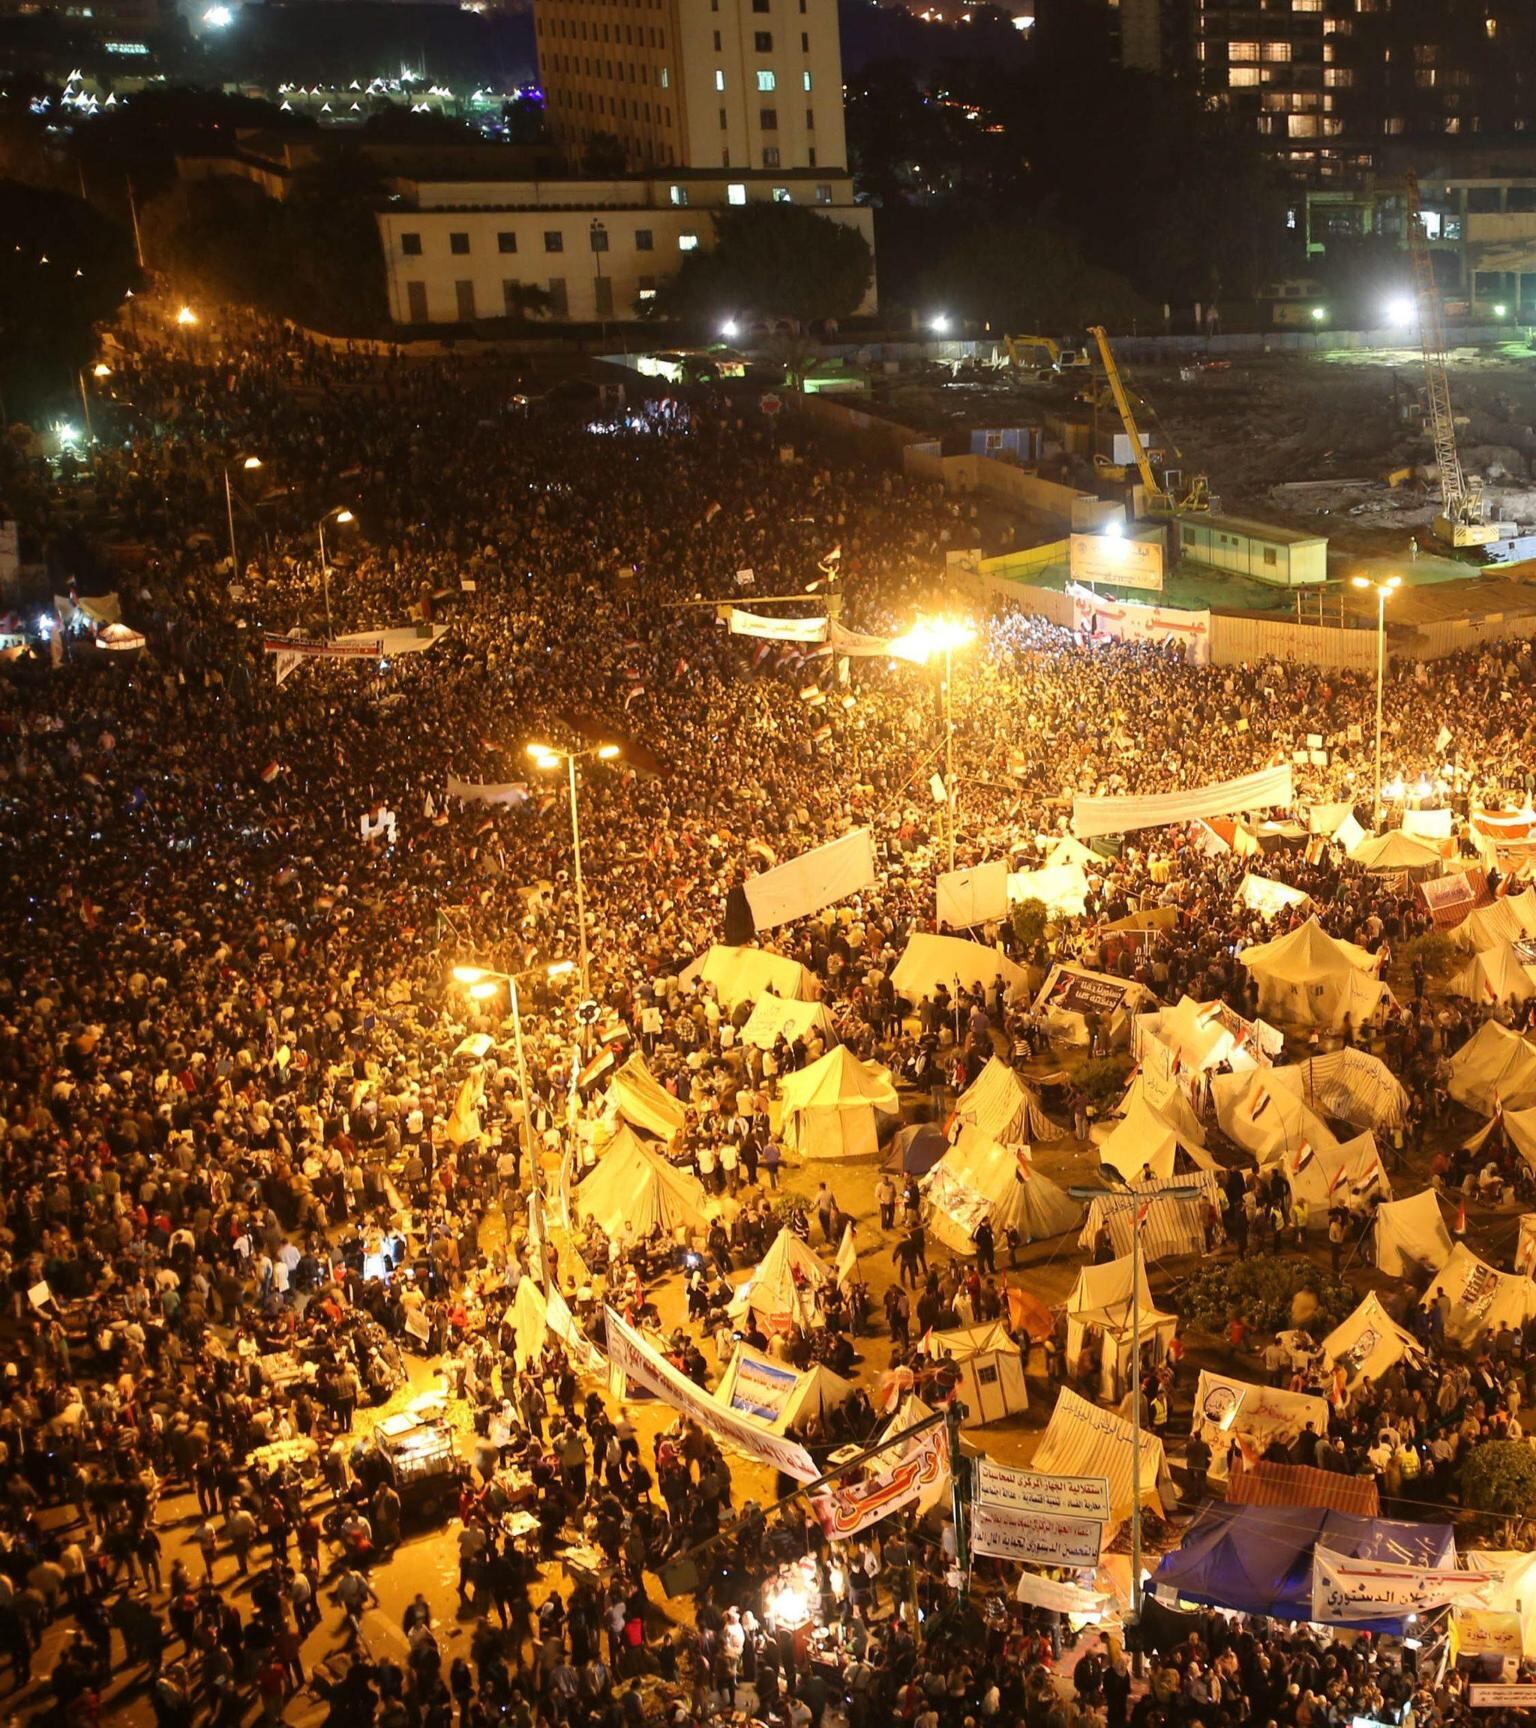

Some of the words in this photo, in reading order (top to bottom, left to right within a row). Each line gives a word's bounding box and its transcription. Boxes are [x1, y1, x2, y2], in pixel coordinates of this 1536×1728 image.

[982, 1467, 1016, 1482] للمحاسبات
[1045, 1481, 1066, 1492] الجهاز
[1068, 1482, 1103, 1496] استقلالية
